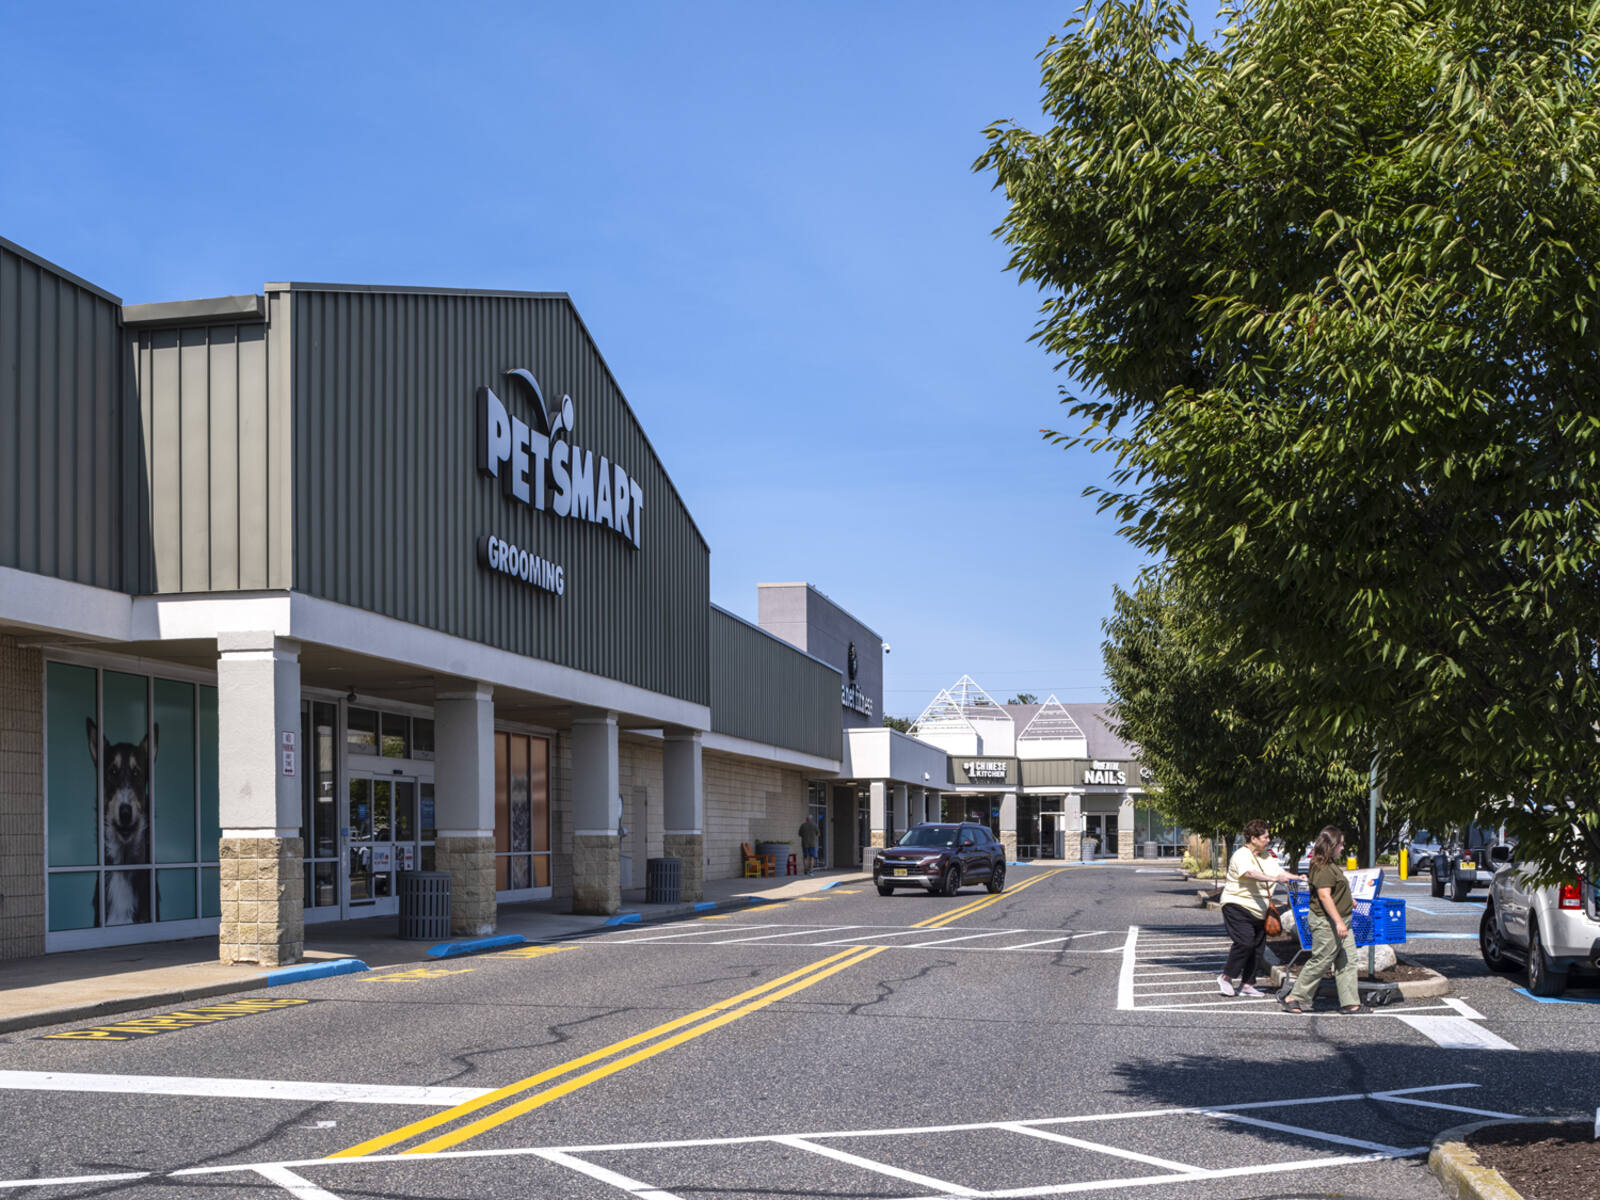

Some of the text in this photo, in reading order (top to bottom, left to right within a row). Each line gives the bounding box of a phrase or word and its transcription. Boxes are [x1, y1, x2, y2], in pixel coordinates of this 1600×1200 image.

[487, 386, 644, 550] PETSMART
[488, 535, 565, 596] GROOMING
[976, 761, 1007, 771] CHINESE
[976, 770, 1006, 778] KITCHEN
[1084, 770, 1126, 785] NAILS
[42, 998, 309, 1041] PARKING
